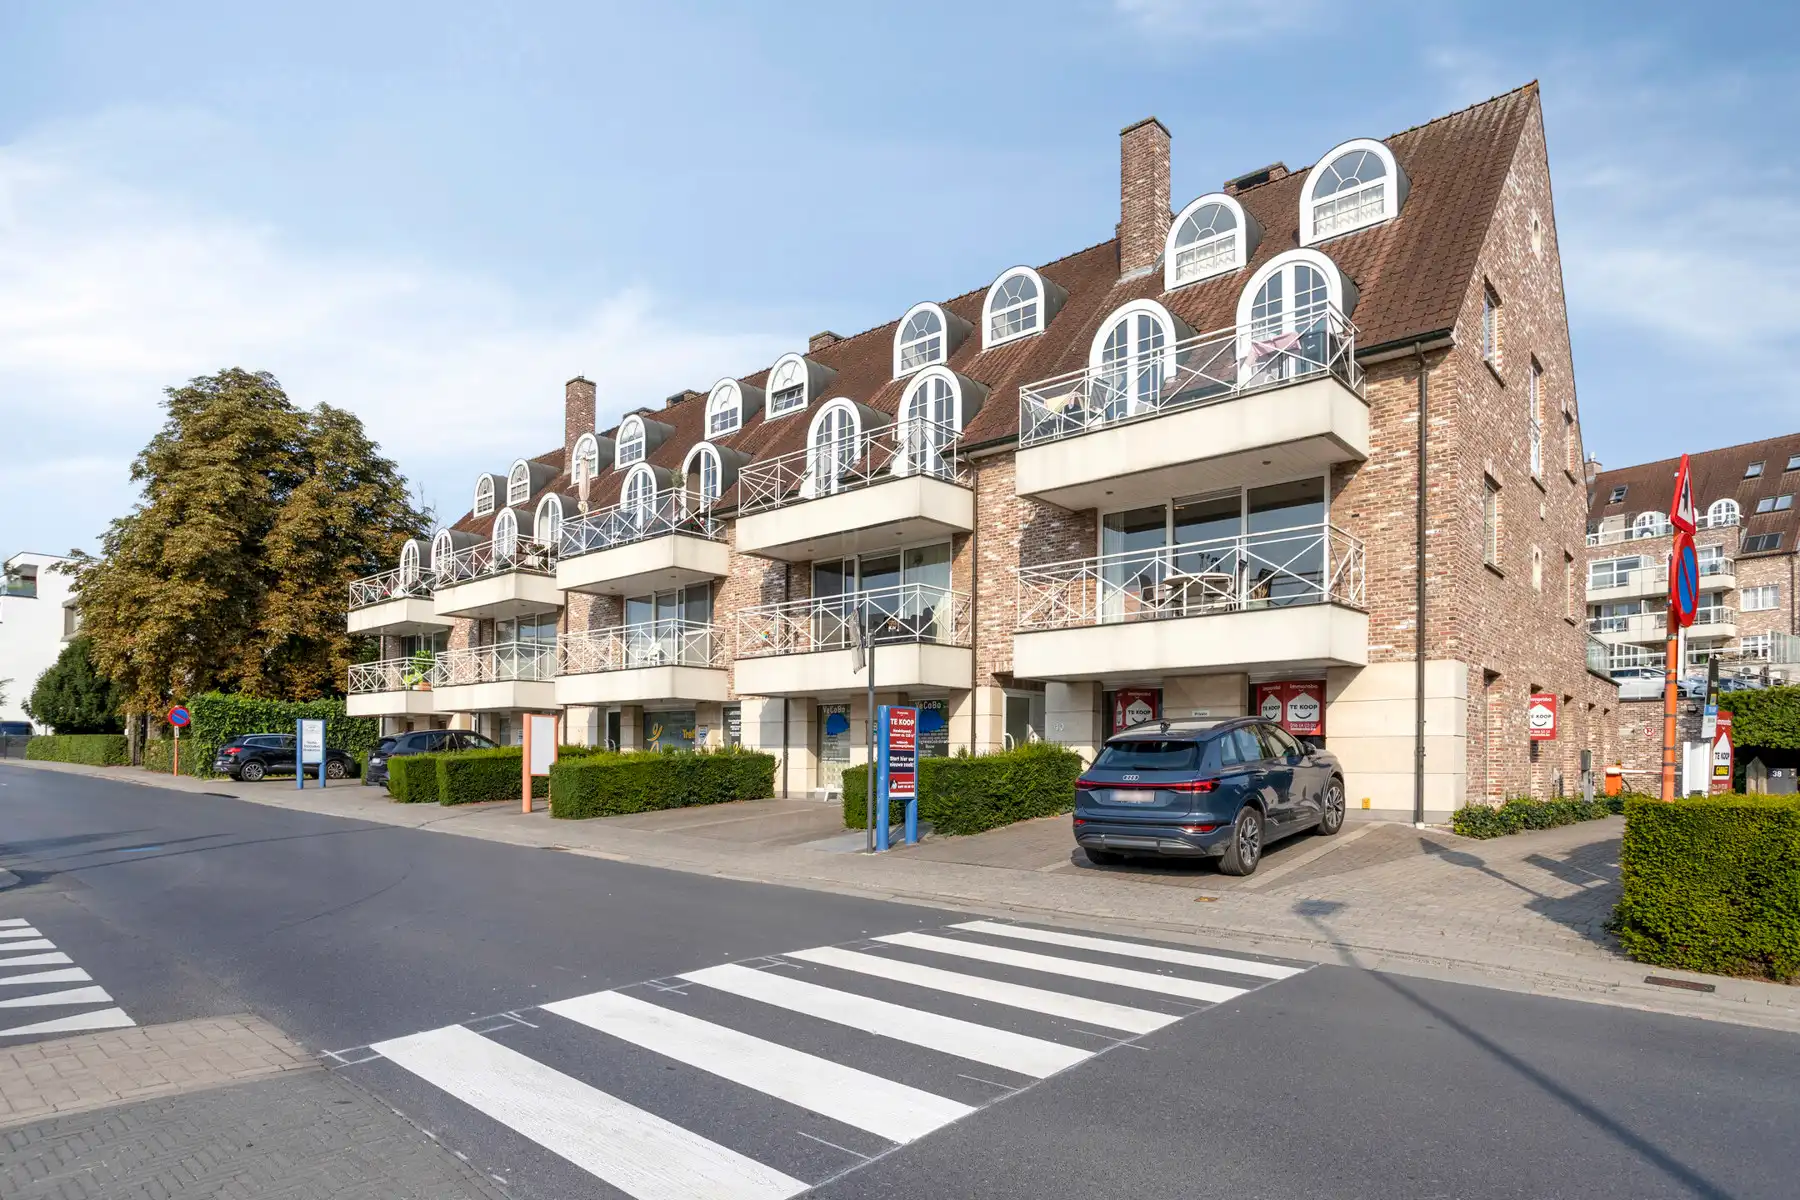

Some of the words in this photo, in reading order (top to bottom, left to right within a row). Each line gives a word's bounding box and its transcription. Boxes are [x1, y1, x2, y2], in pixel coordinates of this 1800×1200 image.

[899, 718, 915, 726] KOOP
[1715, 752, 1720, 760] TE
[1721, 752, 1729, 760] KOOP
